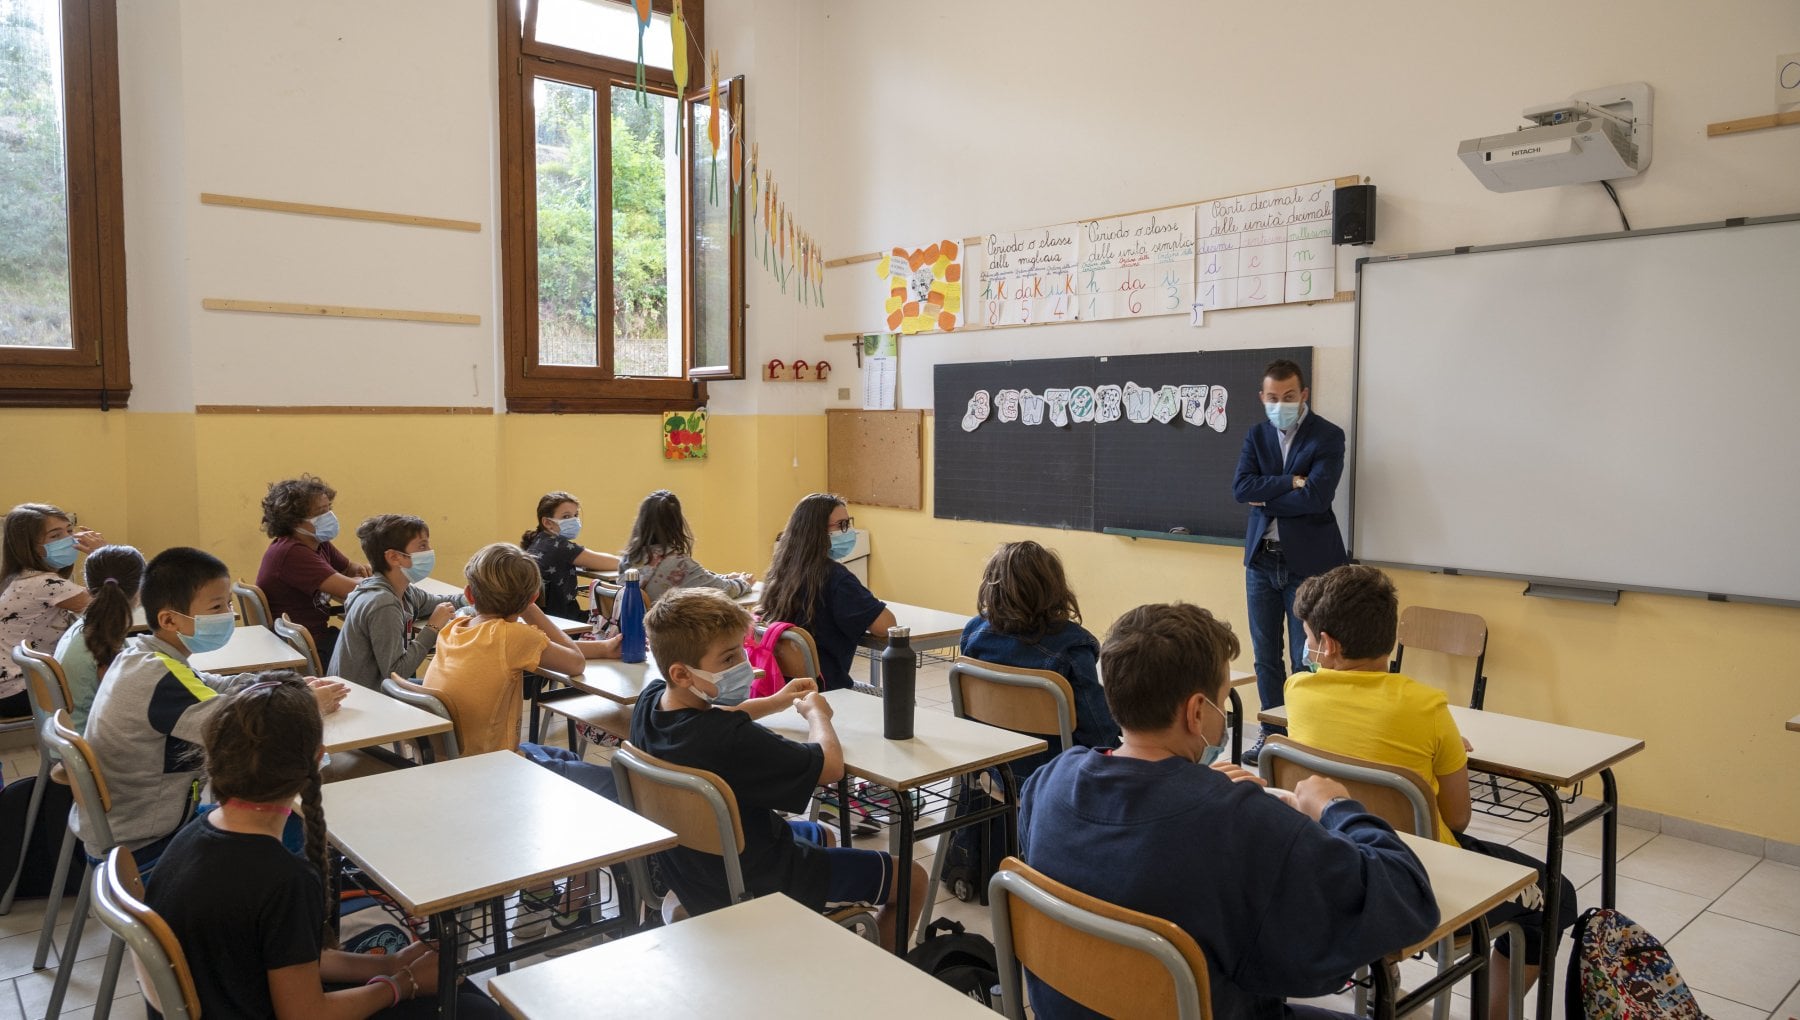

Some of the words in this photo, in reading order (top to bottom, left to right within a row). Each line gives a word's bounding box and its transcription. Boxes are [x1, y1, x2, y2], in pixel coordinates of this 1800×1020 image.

[1511, 147, 1541, 156] HITACHI
[1211, 196, 1246, 218] Parte
[1248, 188, 1303, 212] decimale
[1088, 220, 1130, 242] Periodo
[1134, 227, 1143, 236] o
[1144, 216, 1179, 236] classe
[1209, 217, 1238, 236] delle
[987, 233, 1024, 255] Periodo
[1028, 240, 1036, 250] o
[1039, 230, 1072, 248] classe
[1088, 243, 1115, 262] delle
[989, 254, 1009, 269] delle
[1018, 250, 1062, 271] migliaia
[1205, 254, 1221, 274] d
[1295, 249, 1315, 261] m
[1086, 271, 1100, 293] h
[1118, 269, 1146, 291] da
[1205, 284, 1215, 305] 1
[1249, 276, 1267, 300] 2
[989, 301, 997, 324] 8
[1021, 300, 1030, 321] 5
[1054, 297, 1064, 319] 4
[1089, 297, 1096, 318] 1
[1129, 290, 1142, 313] 6
[1167, 287, 1180, 309] 3
